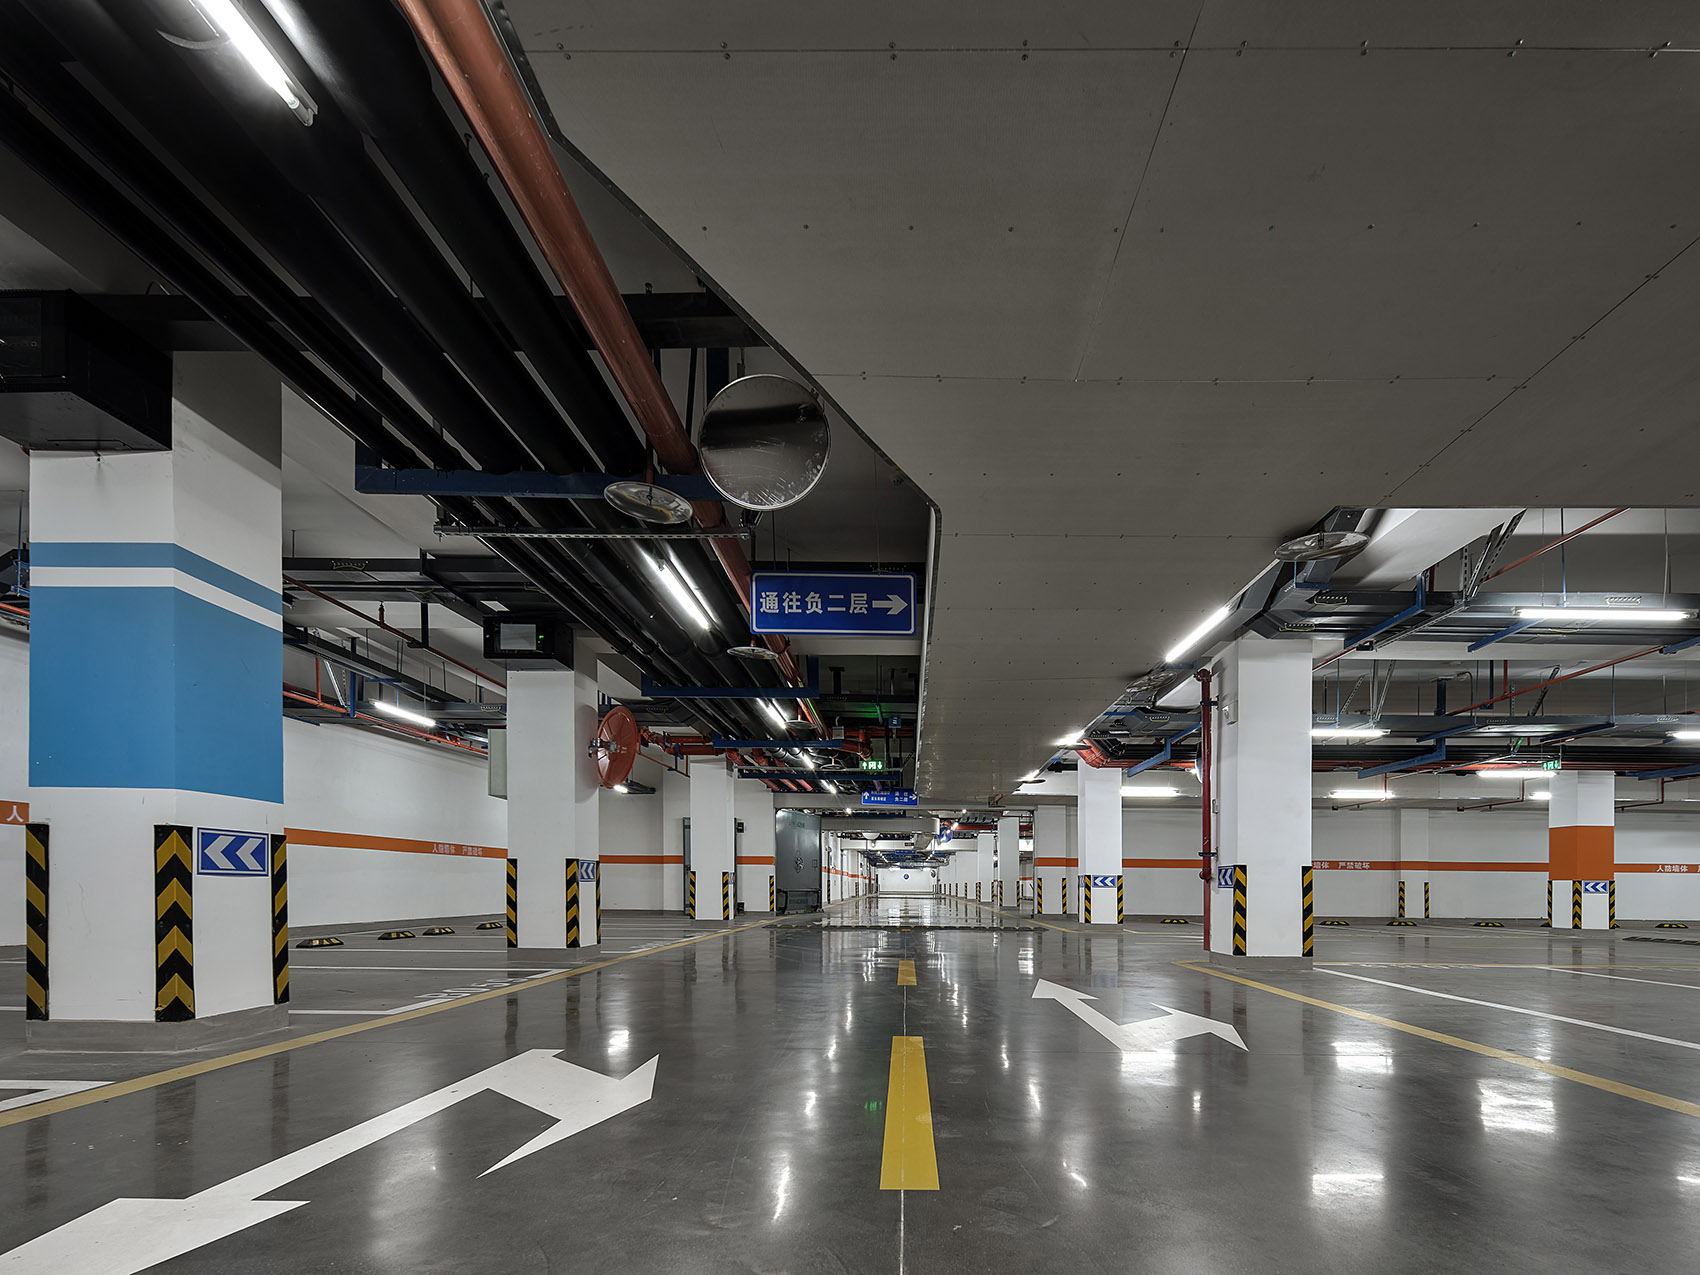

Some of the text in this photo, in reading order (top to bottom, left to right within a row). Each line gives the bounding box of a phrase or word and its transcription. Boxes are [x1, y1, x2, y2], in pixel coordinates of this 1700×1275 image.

[760, 592, 868, 614] 通往负二层
[6, 805, 24, 822] 人
